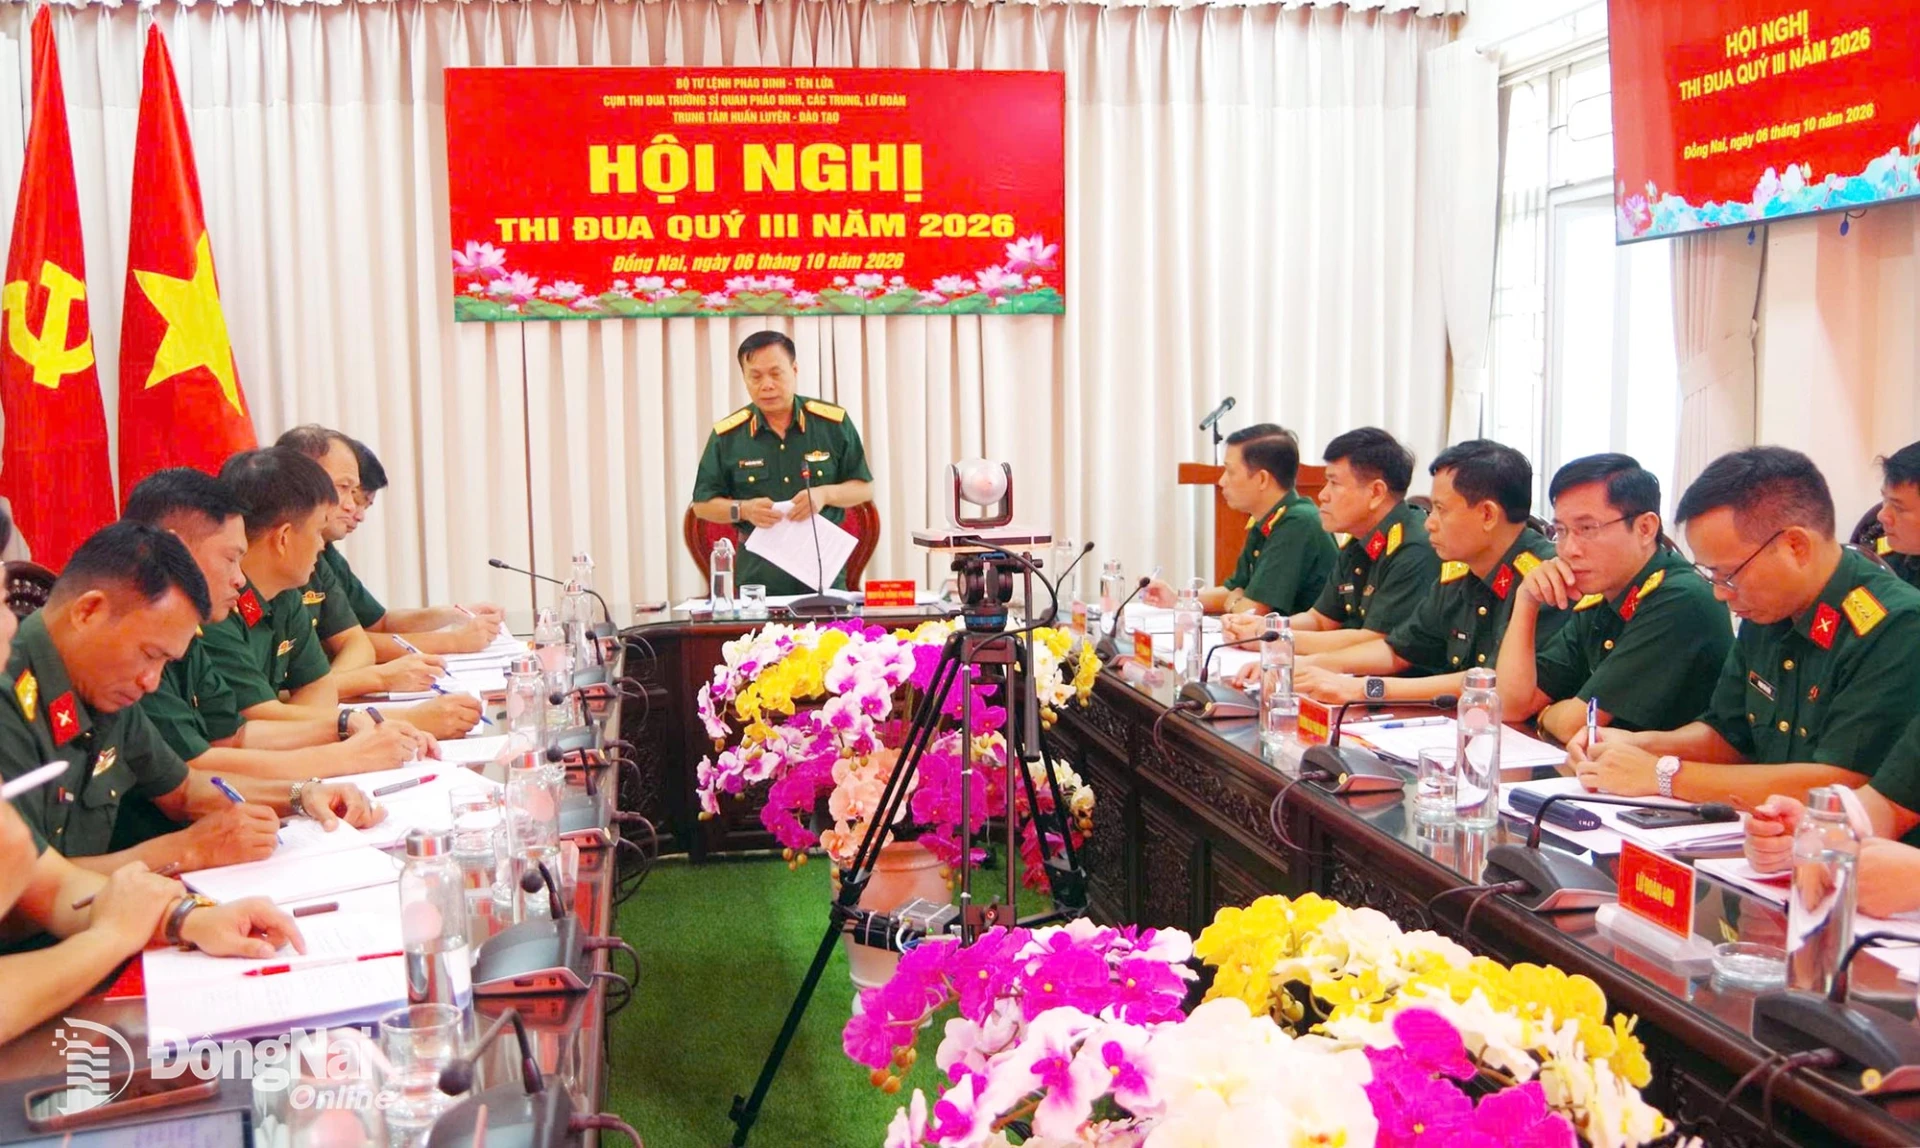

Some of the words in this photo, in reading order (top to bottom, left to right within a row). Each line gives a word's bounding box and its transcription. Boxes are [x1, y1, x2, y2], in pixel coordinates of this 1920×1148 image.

[1725, 26, 1757, 58] HỘI
[1761, 9, 1809, 46] NGHỊ
[1679, 77, 1701, 101] THI
[1703, 68, 1735, 95] ĐUA
[1737, 53, 1769, 85] QUÝ
[1772, 52, 1786, 75] III
[1789, 38, 1827, 71] NĂM
[1830, 27, 1871, 59] 2026
[603, 95, 626, 109] CỤM
[628, 95, 644, 107] THI
[646, 95, 665, 107] ĐUA
[667, 92, 706, 107] TRƯỜNG
[721, 95, 748, 107] QUAN
[750, 93, 776, 107] PHÁO
[778, 95, 805, 107] BINH,
[807, 93, 827, 107] CÁC
[828, 95, 863, 107] TRUNG,
[675, 76, 690, 92] BỘ
[706, 76, 732, 92] LỆNH
[733, 76, 760, 90] PHÁO
[762, 78, 786, 90] BINH
[795, 76, 814, 90] TÊN
[673, 111, 705, 125] TRUNG
[707, 109, 728, 124] TÂM
[730, 108, 757, 124] HUẤN
[759, 109, 790, 125] LUYỆN
[798, 110, 818, 124] ĐÀO
[821, 111, 840, 125] TẠO
[1710, 138, 1729, 155] Nai,
[1730, 131, 1754, 152] ngày
[1756, 126, 1768, 144] 06
[1770, 121, 1801, 140] tháng
[1803, 116, 1816, 133] 10
[1818, 111, 1843, 130] năm
[1846, 102, 1875, 124] 2026
[589, 134, 716, 203] HỘI
[743, 143, 923, 202] NGHỊ
[496, 217, 560, 242] THI
[573, 216, 654, 241] ĐUA
[666, 210, 747, 240] QUÝ
[759, 214, 799, 238] III
[812, 209, 907, 238] NĂM
[919, 214, 1016, 239] 2026
[656, 254, 688, 272] Nai,
[692, 255, 732, 273] ngày
[733, 253, 754, 270] 06
[757, 253, 802, 272] tháng
[806, 253, 823, 270] 10
[827, 253, 861, 270] năm
[865, 252, 905, 270] 2026
